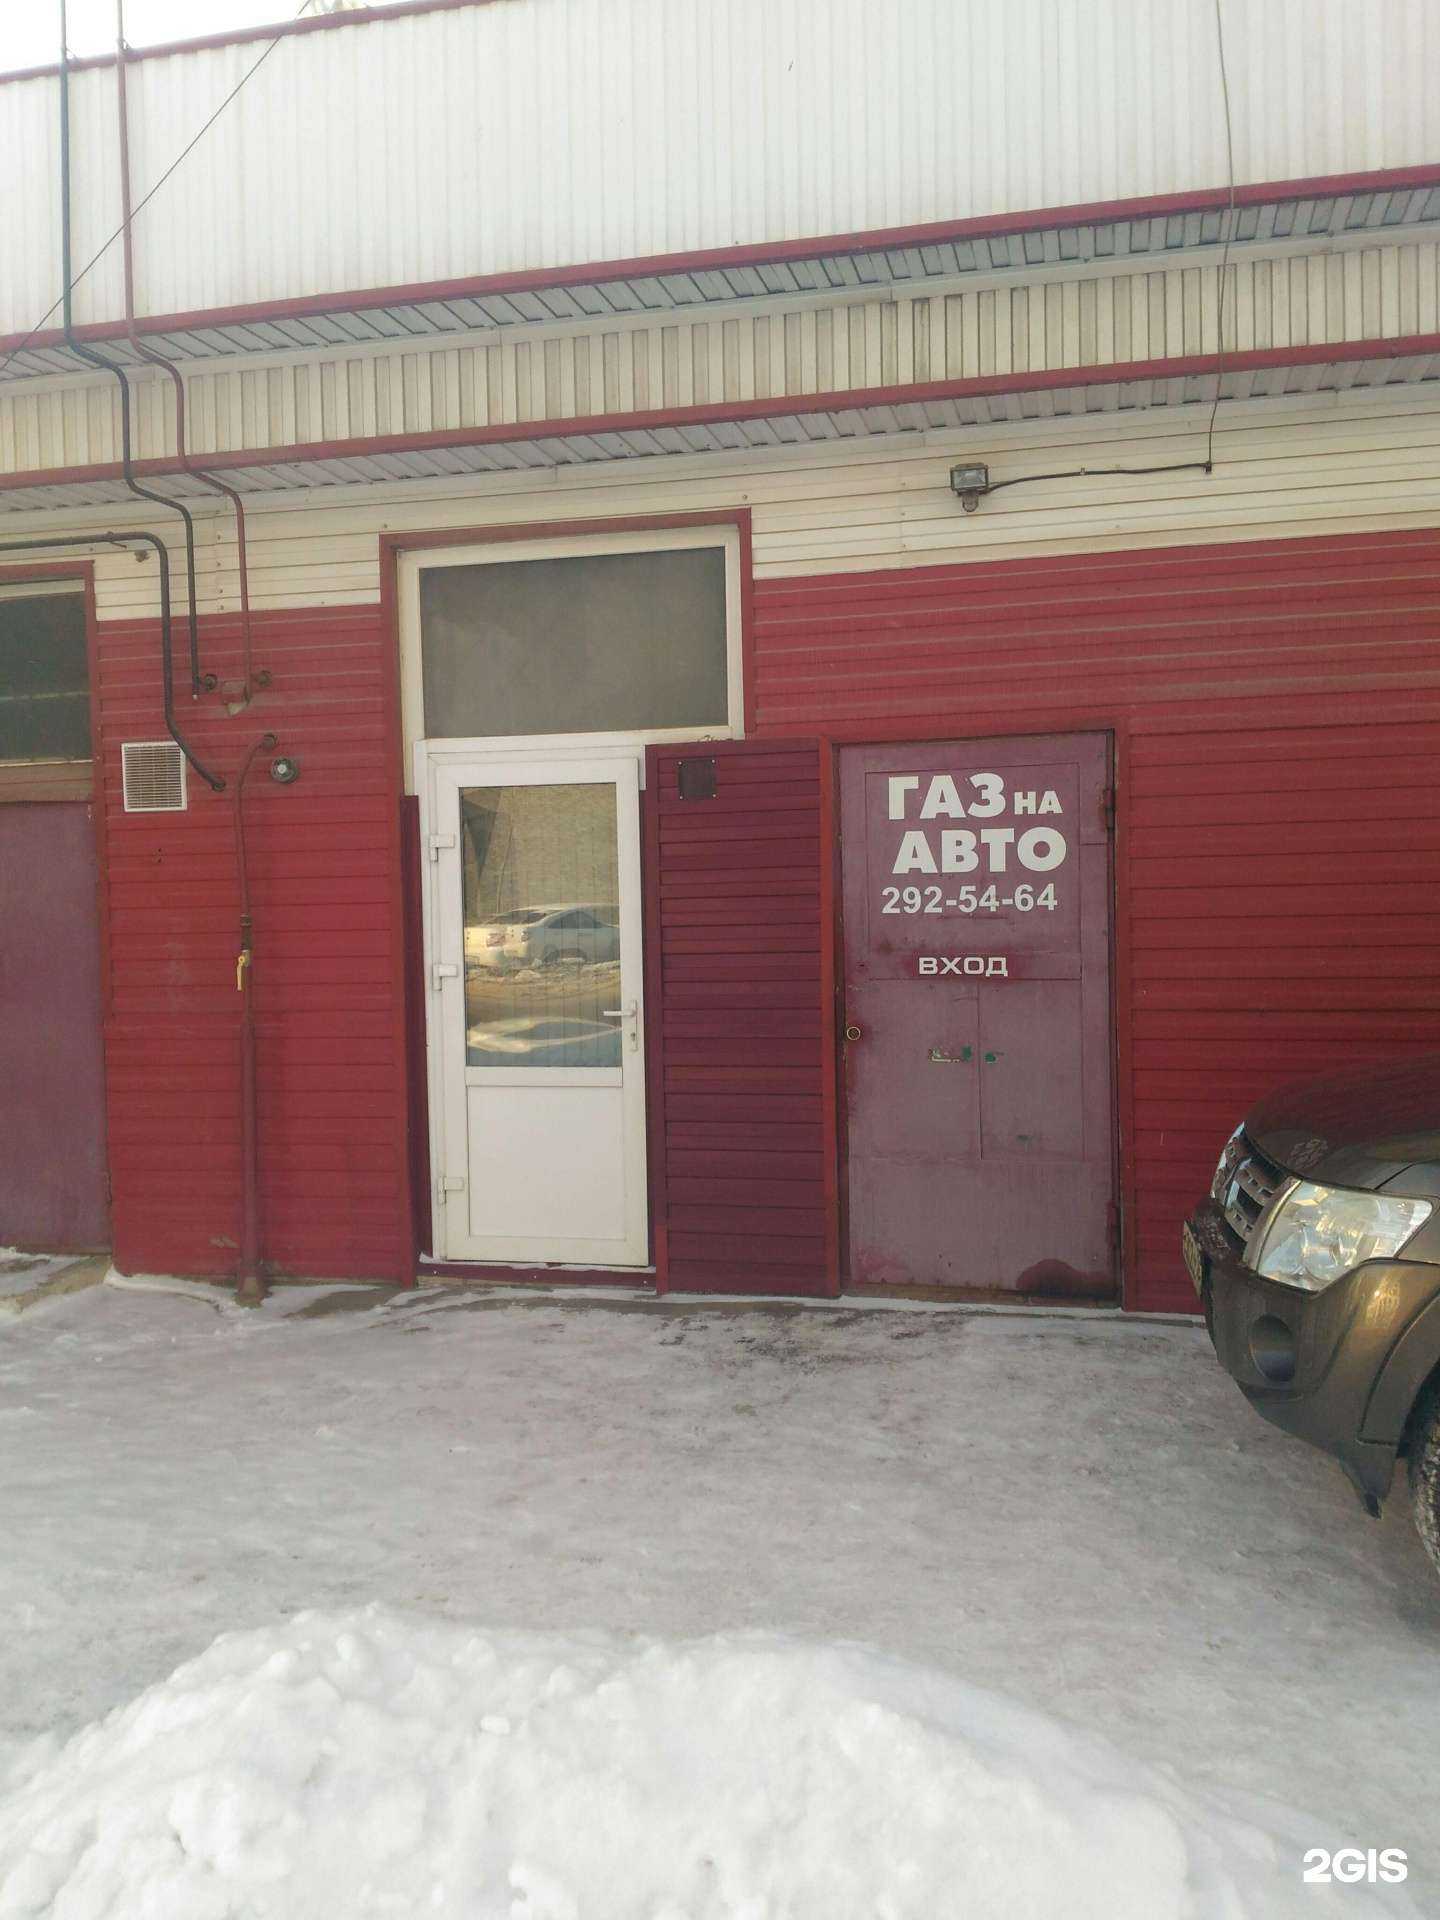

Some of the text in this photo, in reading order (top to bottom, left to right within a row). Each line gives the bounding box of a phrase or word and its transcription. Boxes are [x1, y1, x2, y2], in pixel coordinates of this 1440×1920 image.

[888, 773, 1063, 820] ГАЗ НА
[892, 826, 1067, 874] АВТО
[881, 883, 1058, 914] 292-54-64
[918, 956, 1009, 977] ВХОД
